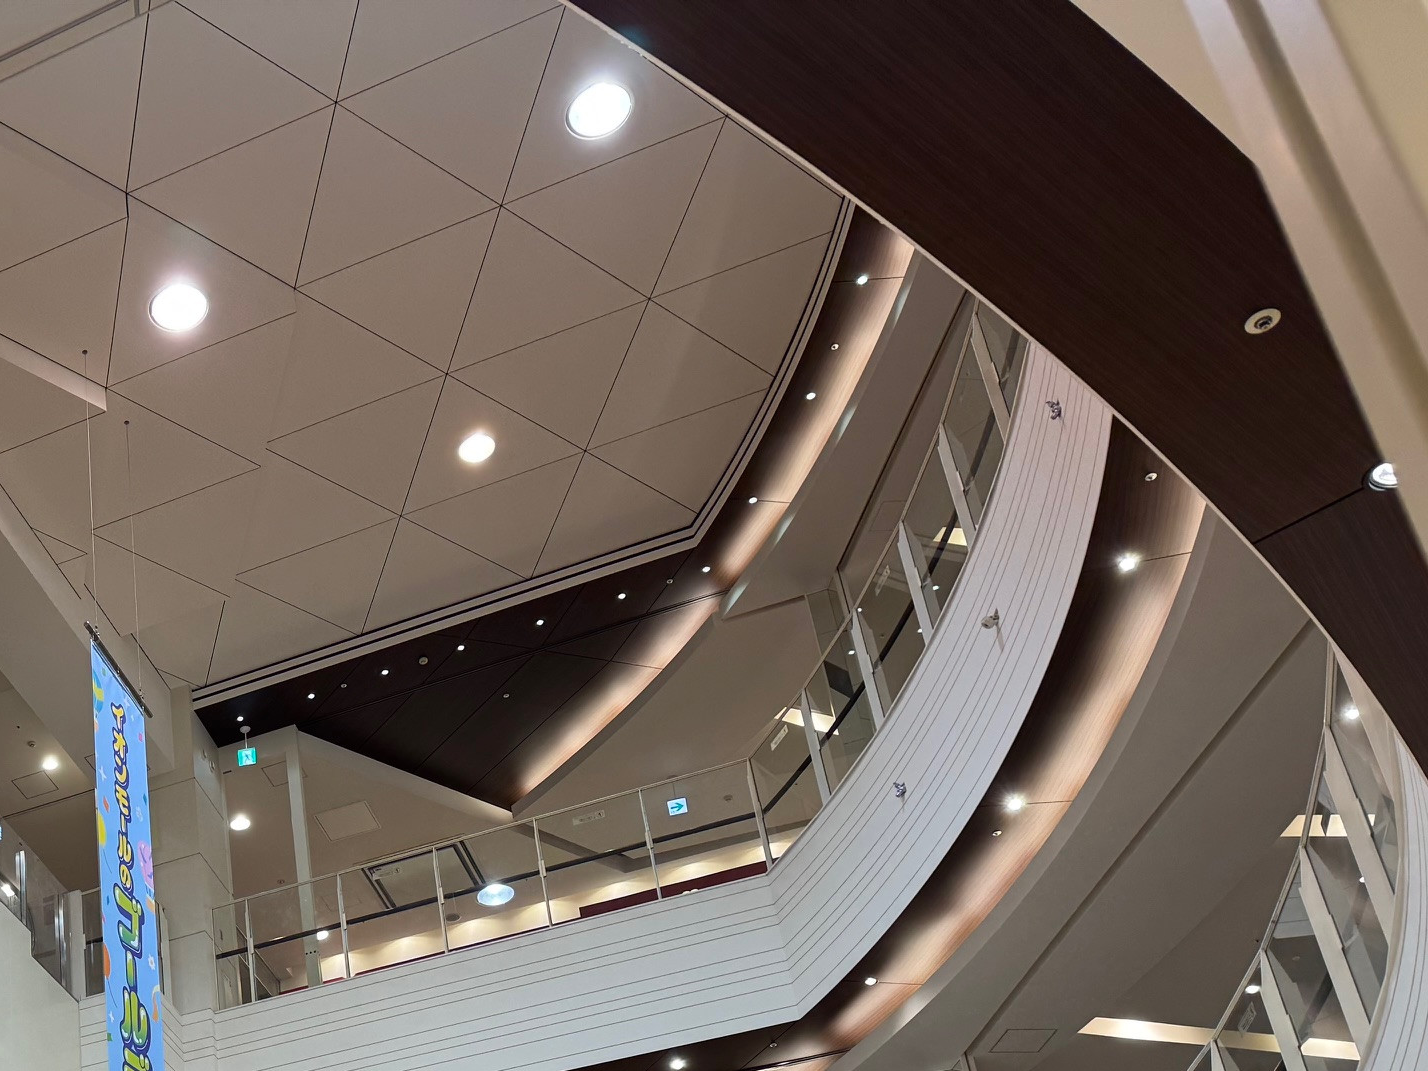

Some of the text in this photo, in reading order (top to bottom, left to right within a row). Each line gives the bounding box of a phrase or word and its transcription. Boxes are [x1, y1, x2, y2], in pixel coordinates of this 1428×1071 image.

[109, 702, 135, 893] イオンモールの
